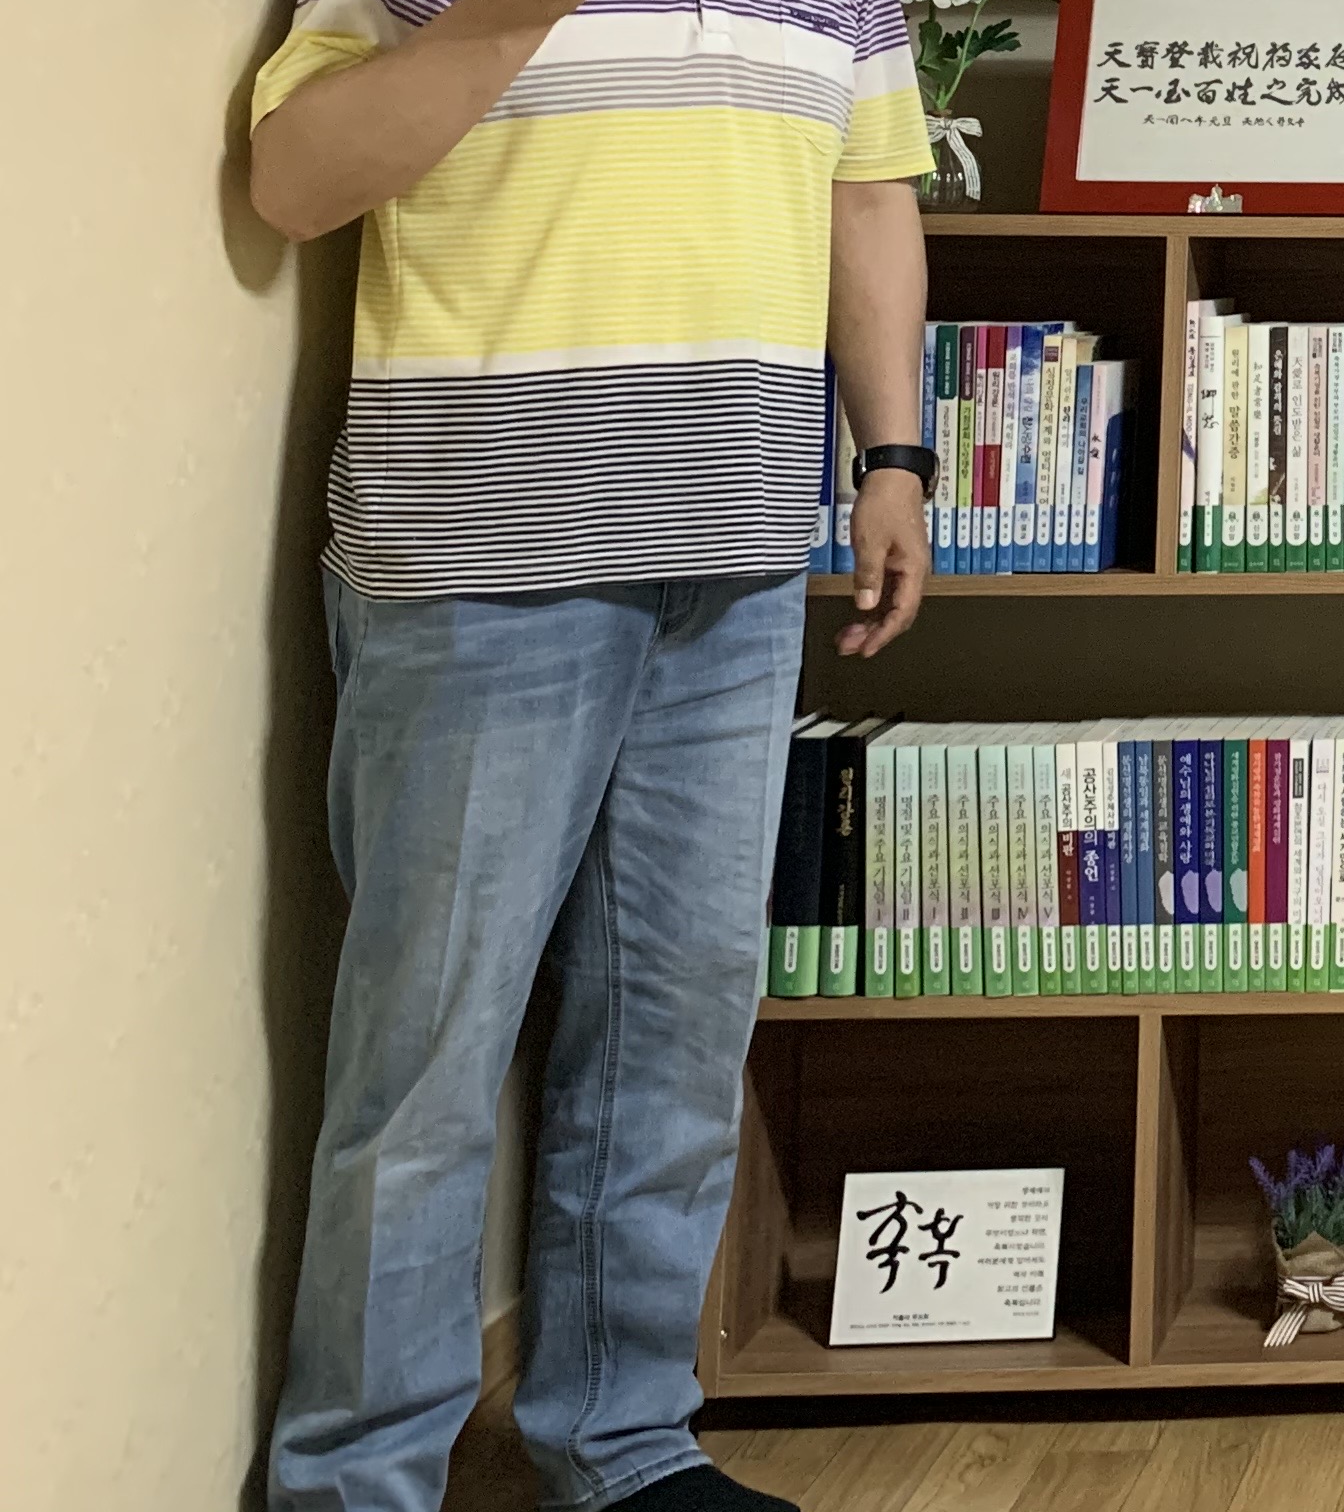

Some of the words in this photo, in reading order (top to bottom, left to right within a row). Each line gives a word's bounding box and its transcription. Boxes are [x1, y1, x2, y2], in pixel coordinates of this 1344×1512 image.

[1231, 348, 1240, 378] 원리에
[1228, 405, 1241, 460] 말씀간증
[1179, 753, 1192, 800] 예수님의
[874, 794, 887, 821] 명절
[900, 794, 913, 821] 명절
[927, 794, 941, 820] 주요
[957, 794, 970, 820] 주요
[987, 794, 1001, 820] 주요
[1014, 794, 1028, 820] 주요
[1039, 794, 1053, 820] 주요
[1061, 784, 1073, 830] 공산주의
[1082, 767, 1099, 846] 공산주의의
[1179, 801, 1192, 838] 생애와
[1062, 831, 1075, 857] 비판
[1179, 840, 1192, 865] 사랑
[1083, 849, 1100, 883] 종언
[874, 865, 887, 905] 기념일
[900, 865, 913, 905] 기념일
[855, 1190, 965, 1295] 축복
